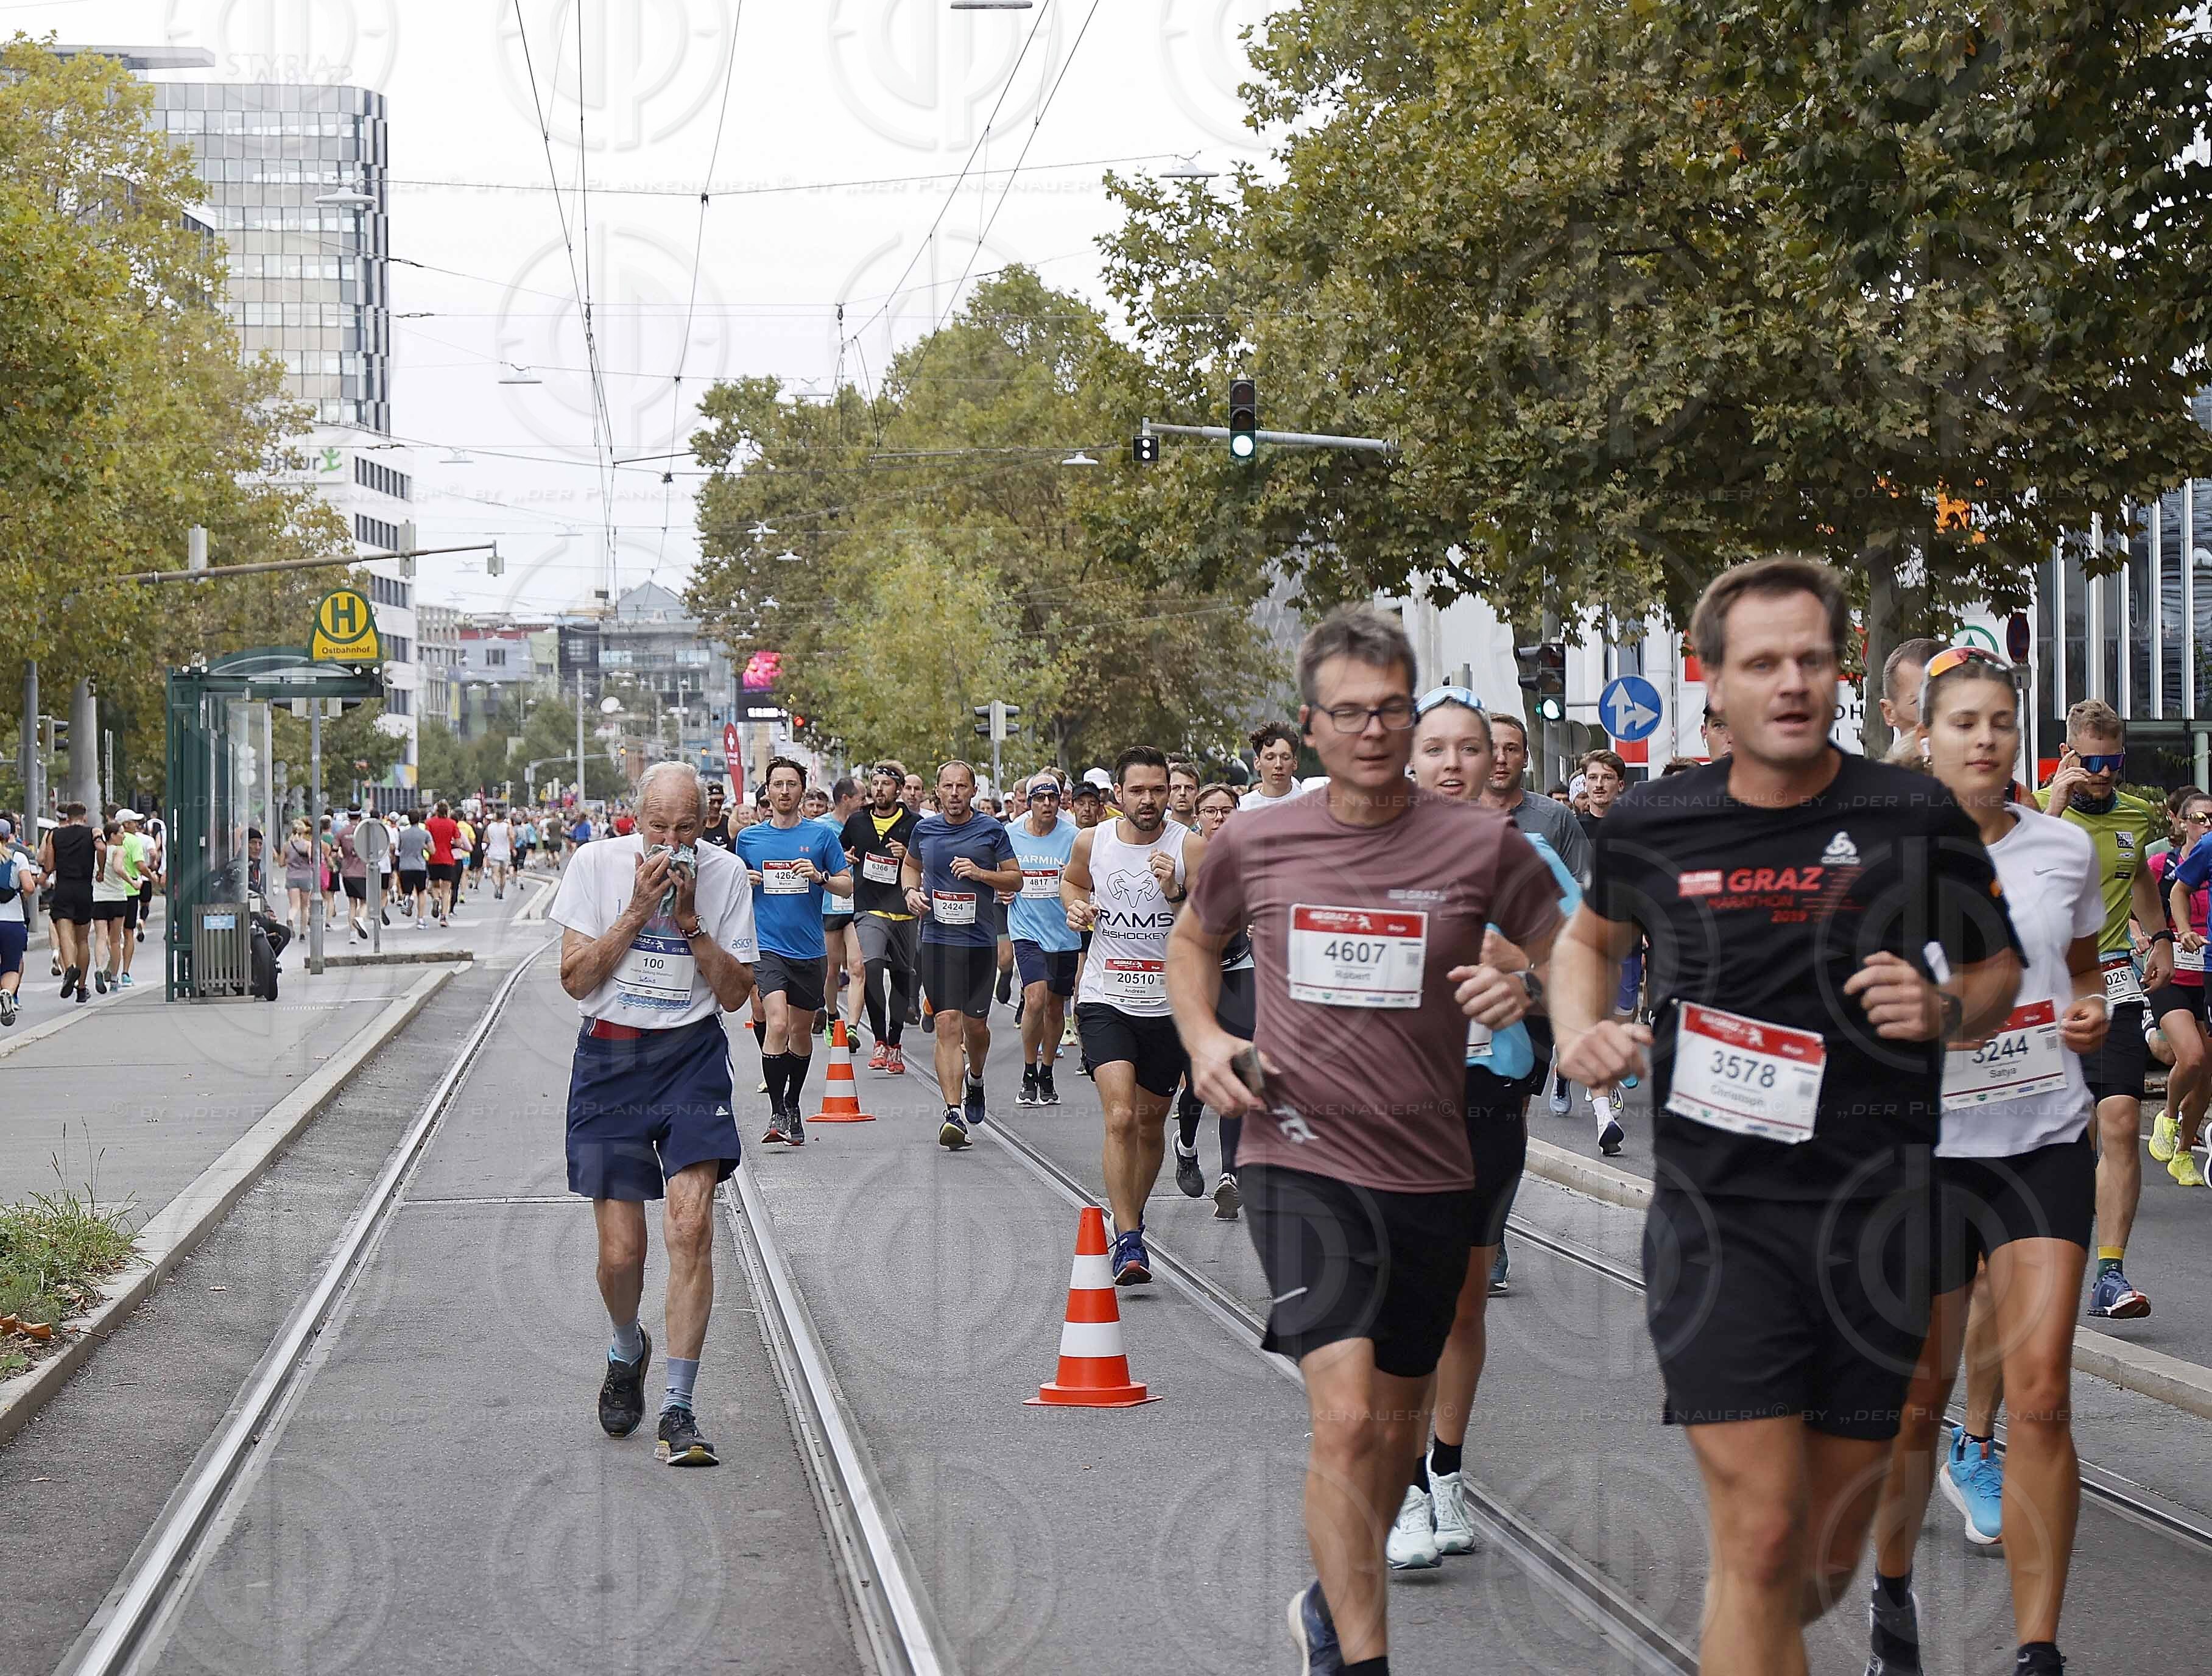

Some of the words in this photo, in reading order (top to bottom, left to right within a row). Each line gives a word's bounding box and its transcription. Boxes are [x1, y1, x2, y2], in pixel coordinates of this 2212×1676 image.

[261, 453, 320, 471] erkur
[331, 597, 356, 633] H
[321, 646, 370, 654] Ostbahnhof
[1016, 854, 1063, 865] GARMIN
[872, 862, 889, 871] 6366
[1727, 867, 1825, 892] GRAZ
[942, 902, 963, 910] 2424
[1100, 909, 1174, 928] RAMS
[1102, 929, 1169, 940] EISHOCKEY
[1324, 940, 1387, 964] 4607
[643, 957, 664, 970] 100
[1116, 973, 1155, 985] 20510
[1334, 969, 1371, 980] Robert
[1710, 1050, 1777, 1088] 3578
[1988, 1068, 2017, 1079] Satya
